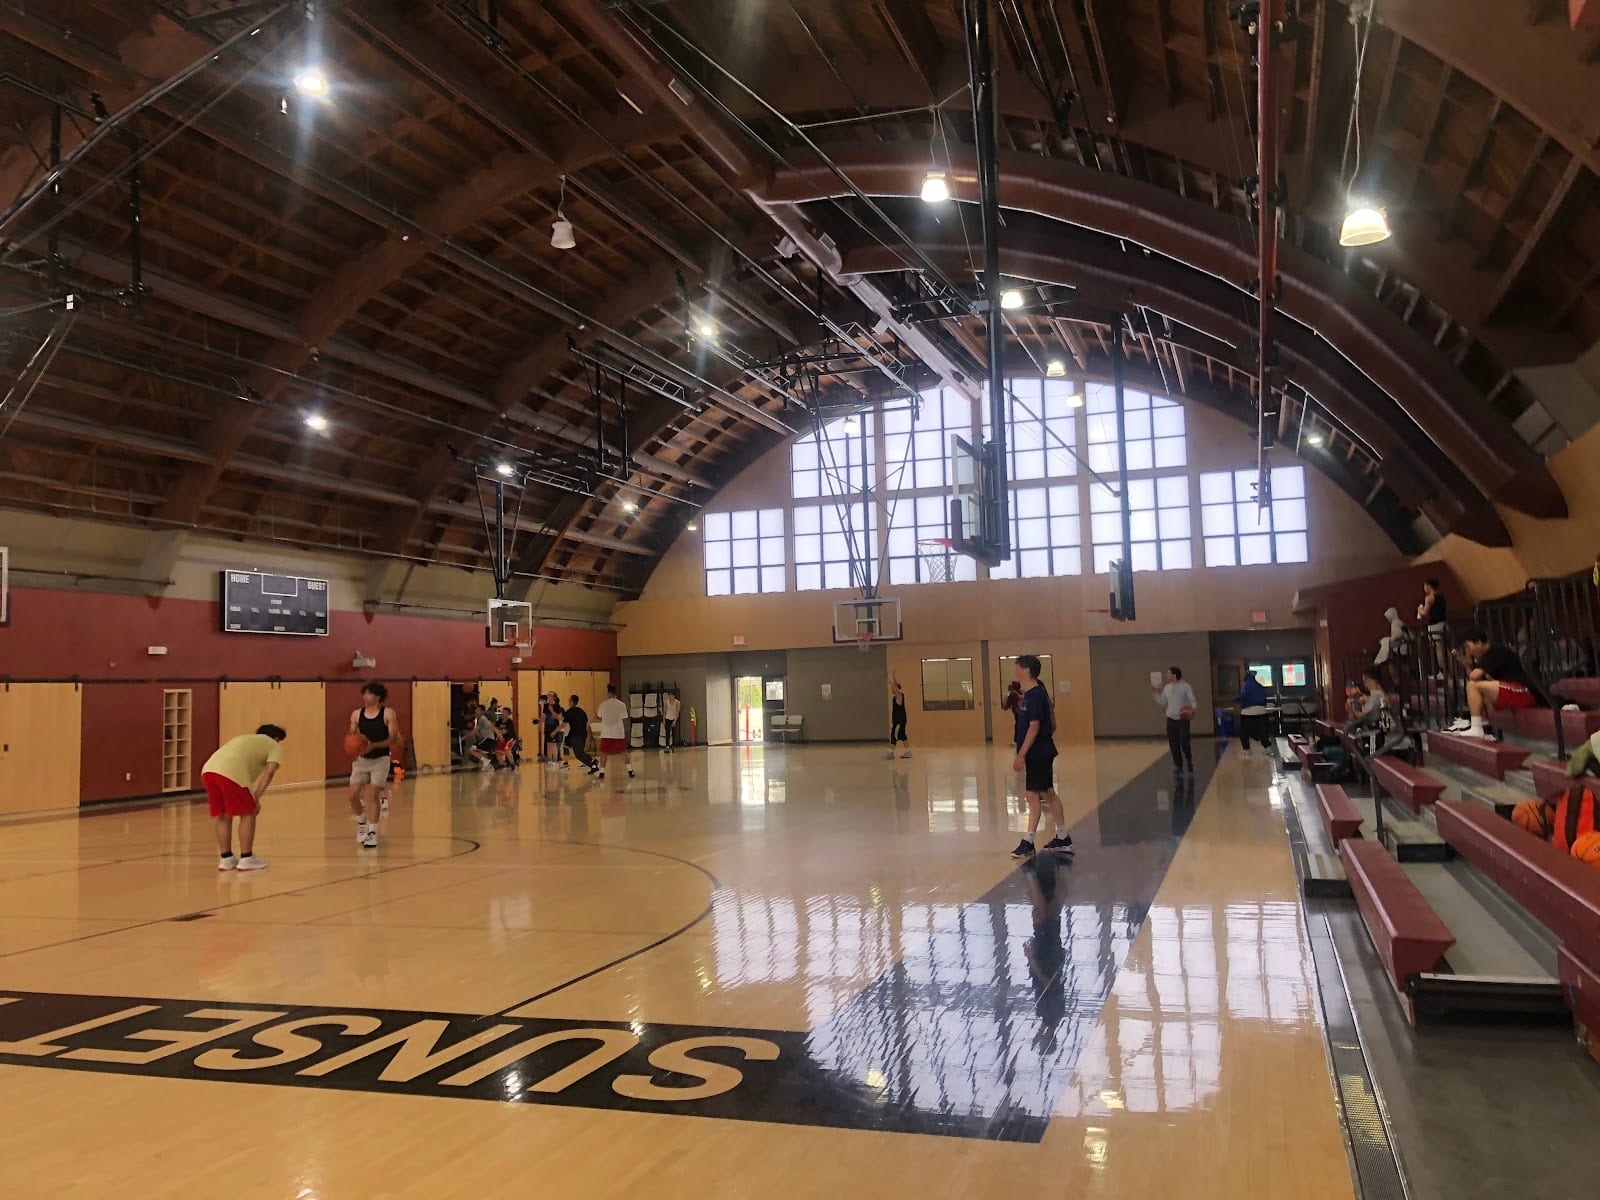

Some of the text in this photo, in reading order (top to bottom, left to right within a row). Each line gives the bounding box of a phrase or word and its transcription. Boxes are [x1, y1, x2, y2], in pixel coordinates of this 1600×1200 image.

[230, 574, 250, 584] HOME
[307, 581, 326, 591] GUEST
[0, 1004, 781, 1101] SUNSET
